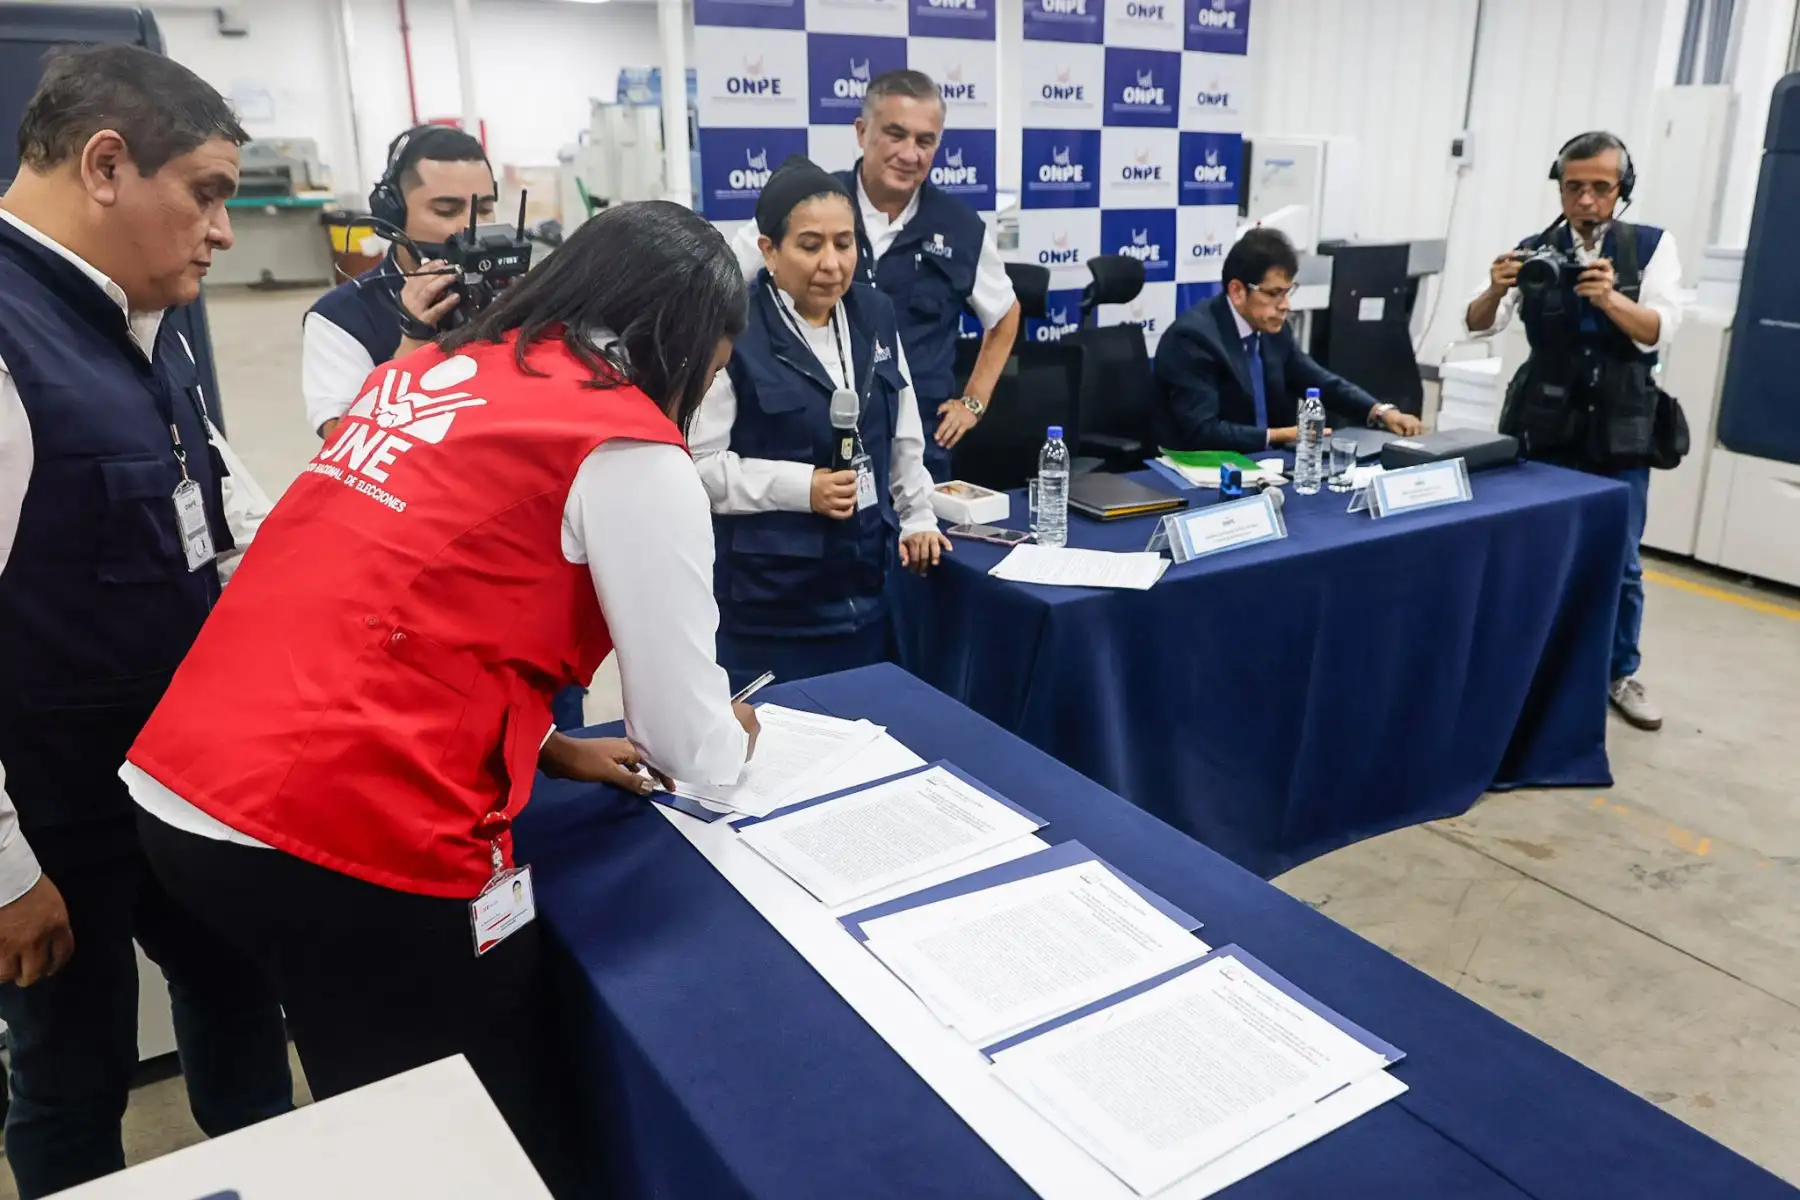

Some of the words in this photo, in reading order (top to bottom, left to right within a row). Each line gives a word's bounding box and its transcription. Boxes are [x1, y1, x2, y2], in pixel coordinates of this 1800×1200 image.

[1126, 2, 1164, 20] ONPE
[1198, 9, 1236, 29] ONPE
[727, 77, 781, 95] ONPE
[833, 78, 867, 98] ON
[939, 83, 976, 99] NPE
[1042, 84, 1084, 100] ONPE
[1122, 86, 1165, 105] ONPE
[1197, 91, 1229, 107] ONPE
[930, 166, 977, 185] ONPE
[1038, 164, 1084, 182] ONPE
[1122, 165, 1162, 181] ONPE
[1194, 165, 1227, 182] ONPE
[1038, 248, 1080, 264] ONPE
[1192, 244, 1222, 258] ONPE
[320, 422, 413, 483] JNE
[344, 474, 358, 487] DE
[355, 480, 407, 513] ELECCIONES
